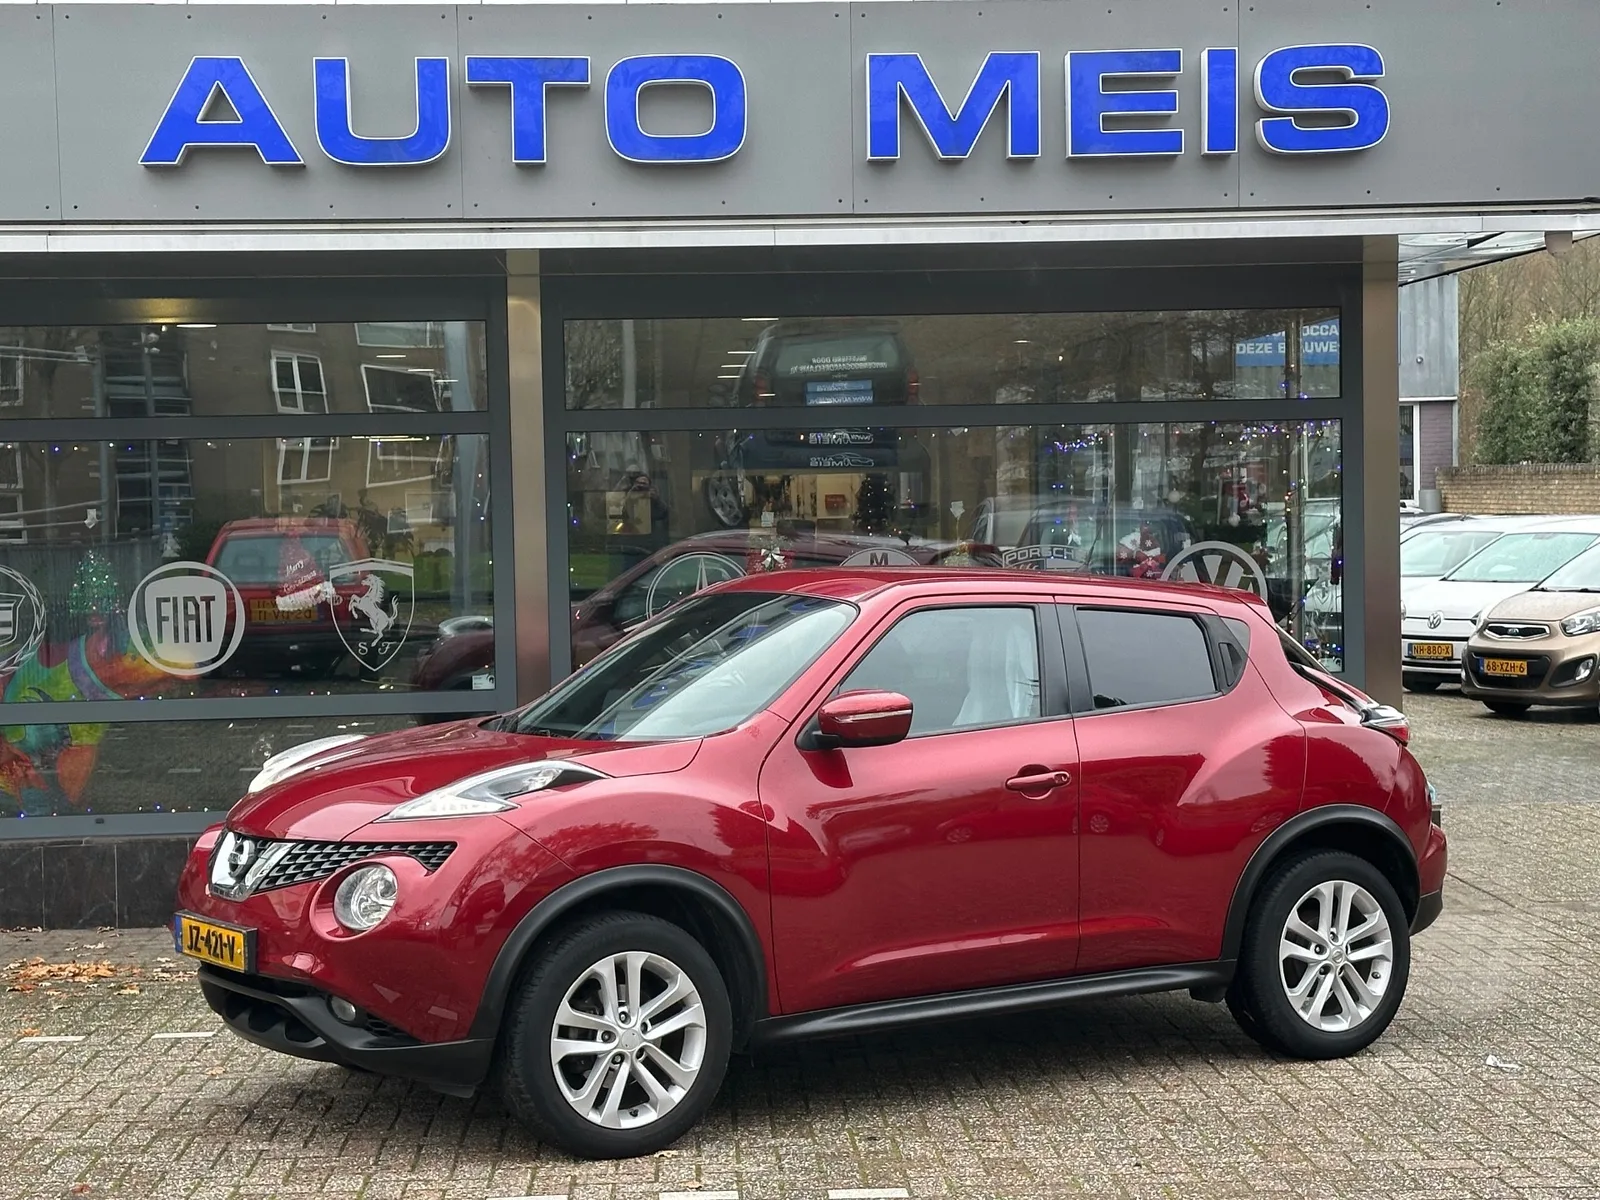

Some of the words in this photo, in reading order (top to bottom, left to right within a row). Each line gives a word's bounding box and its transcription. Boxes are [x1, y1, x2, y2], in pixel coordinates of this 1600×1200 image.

[138, 53, 748, 167] AUTO
[866, 43, 1391, 161] MEIS
[1235, 343, 1273, 355] DEZE
[1006, 547, 1083, 565] PORSCH
[155, 595, 216, 644] FIAT
[1413, 645, 1451, 655] NH-880-X
[1486, 660, 1526, 674] 68-XZH-6
[187, 924, 236, 962] JZ-421-V
